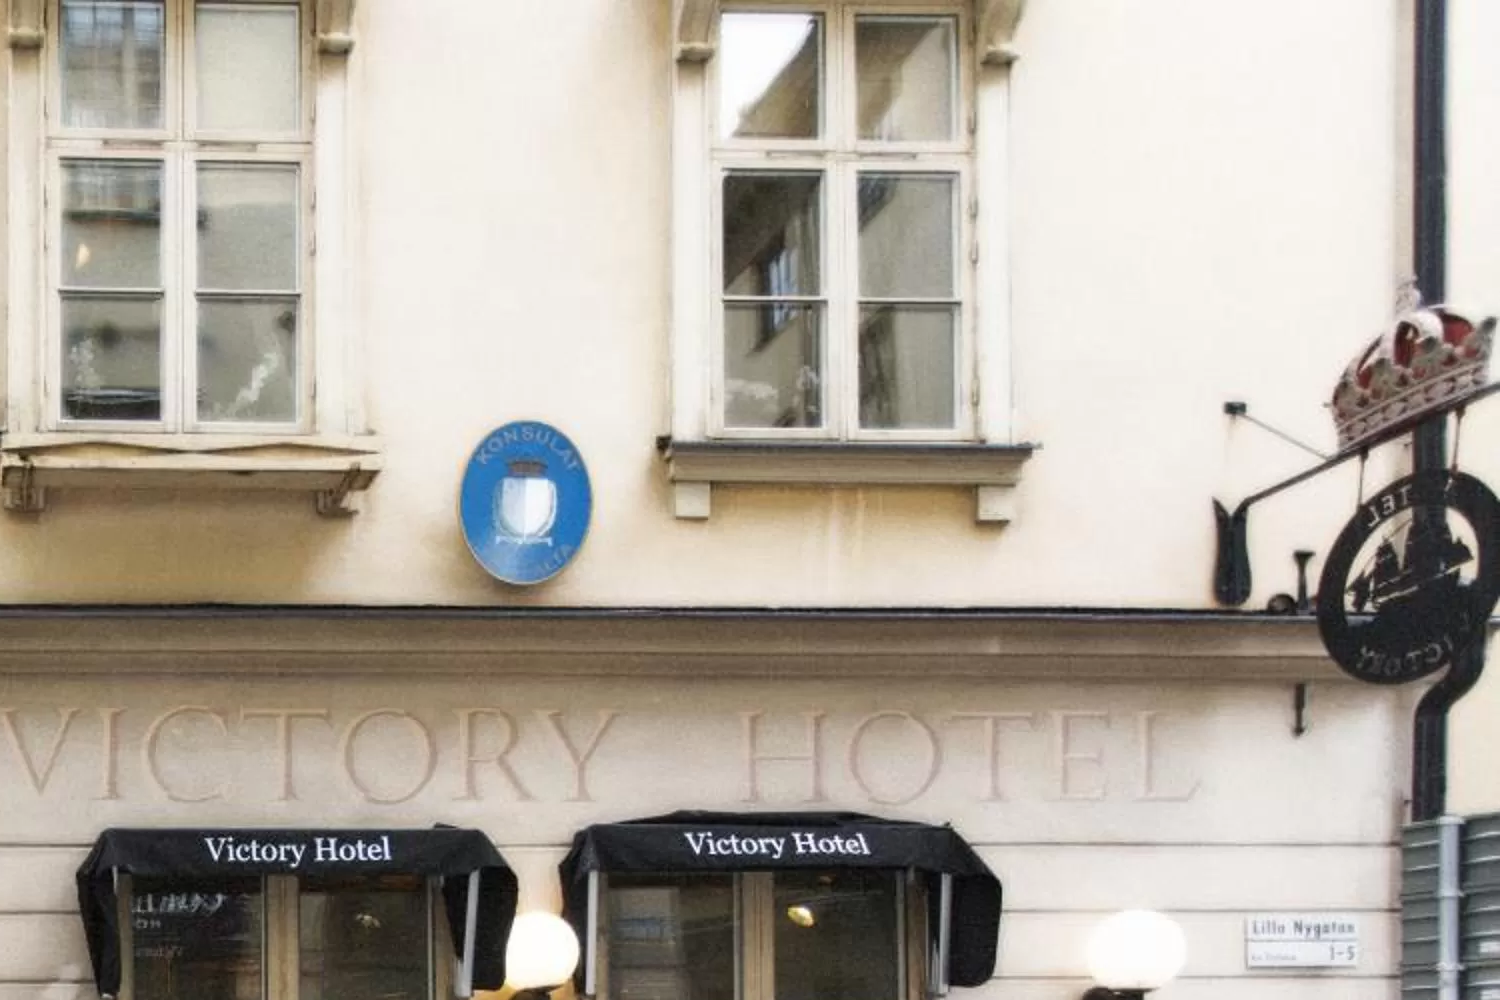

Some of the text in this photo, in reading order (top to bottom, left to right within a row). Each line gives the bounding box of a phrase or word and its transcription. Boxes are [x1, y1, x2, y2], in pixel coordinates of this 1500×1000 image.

[475, 425, 580, 475] KONSULAT
[0, 705, 1201, 805] VICTORY HOTEL
[204, 836, 392, 868] Victory Hotel
[684, 832, 871, 859] Victory Hotel
[1252, 920, 1356, 940] Lilla Nygatan
[1329, 944, 1356, 961] 1-5
